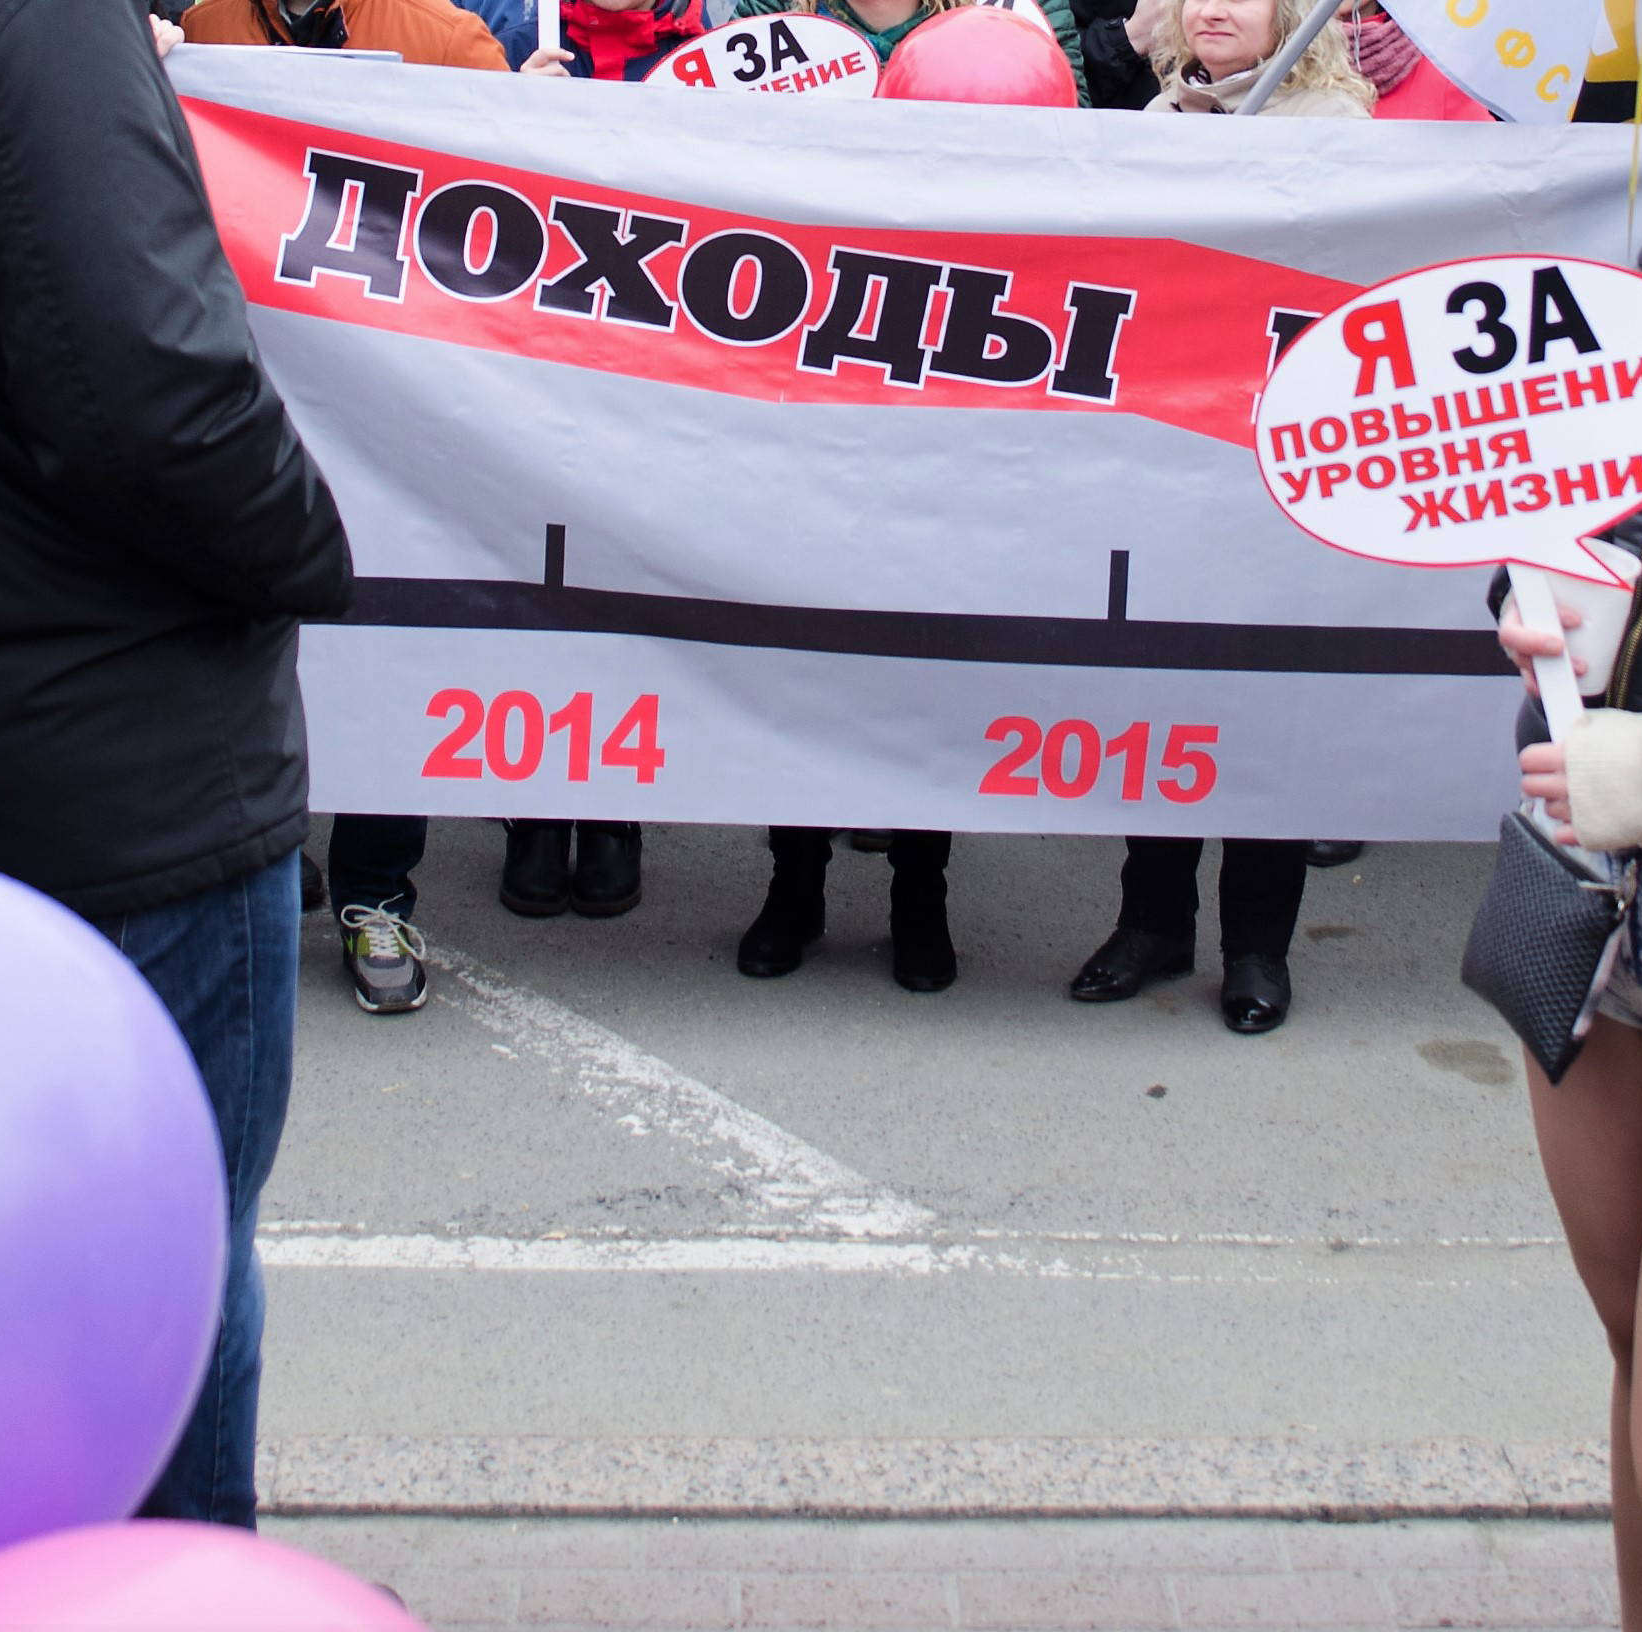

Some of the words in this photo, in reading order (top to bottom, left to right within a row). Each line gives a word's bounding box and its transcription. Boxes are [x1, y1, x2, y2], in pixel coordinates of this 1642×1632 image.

[672, 48, 716, 88] Я
[725, 19, 810, 81] ЗА
[274, 146, 1137, 405] ДОХОДЫ
[1342, 299, 1417, 397] Я
[1445, 266, 1600, 375] ЗА
[1278, 428, 1532, 505] УРОВНЯ
[421, 687, 665, 785] 2014
[979, 715, 1219, 804] 2015
